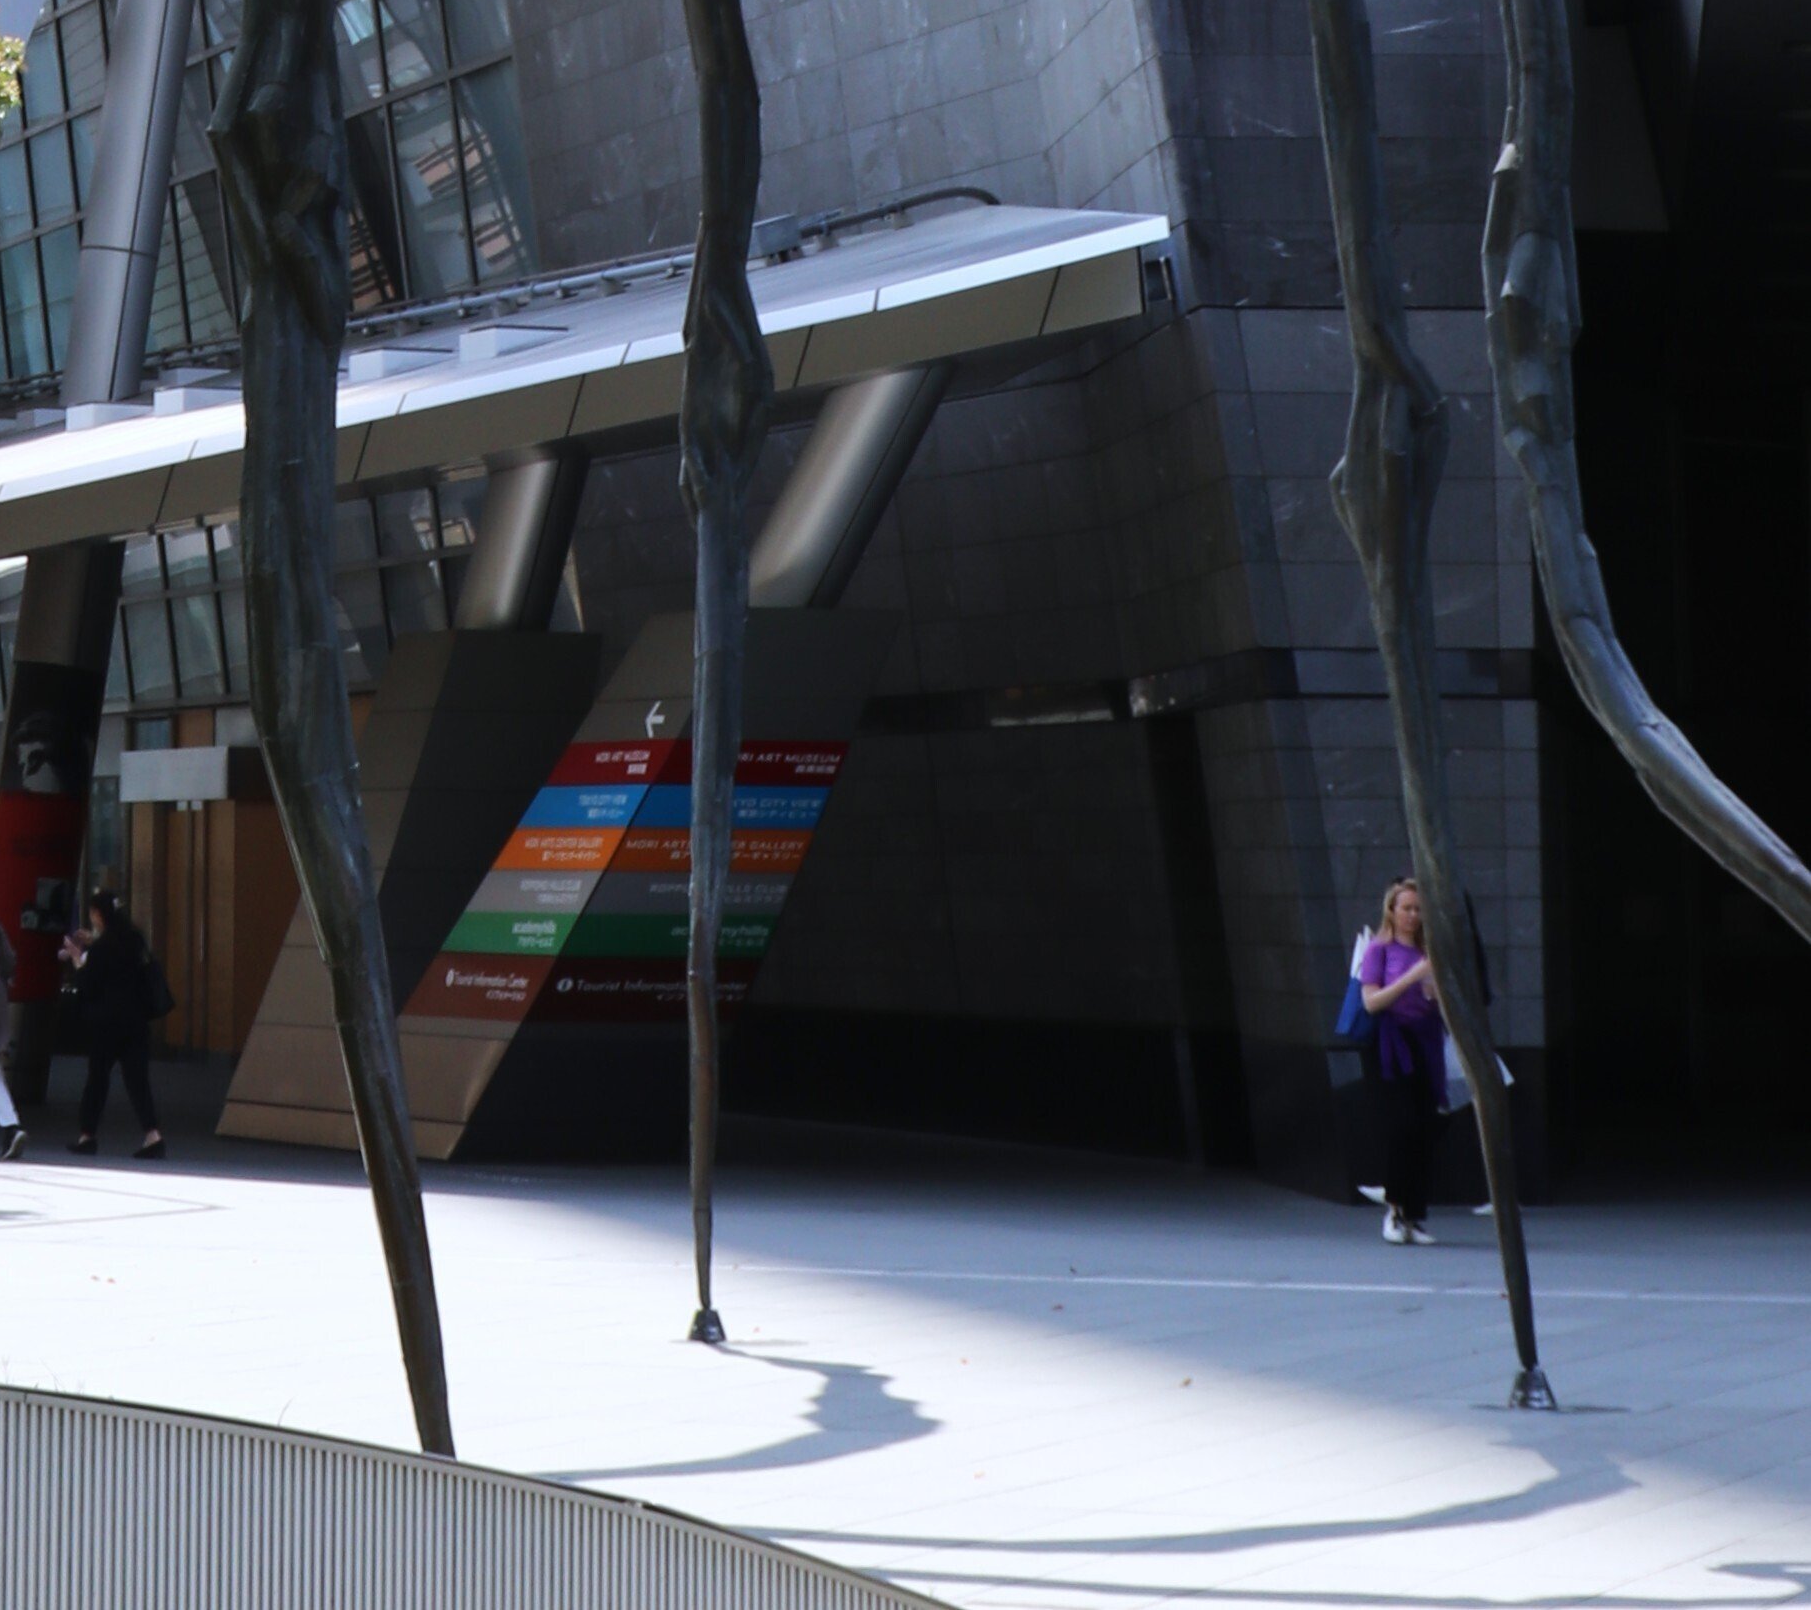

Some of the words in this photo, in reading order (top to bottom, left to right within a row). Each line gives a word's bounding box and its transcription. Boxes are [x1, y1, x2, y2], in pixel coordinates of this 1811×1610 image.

[756, 752, 782, 763] ART
[784, 753, 841, 763] MUSEUM
[760, 798, 788, 808] CITY
[626, 840, 659, 849] MORI
[749, 840, 804, 850] GALLERY
[577, 980, 621, 992] Tourist
[623, 980, 689, 992] Informati
[715, 982, 747, 992] enter
